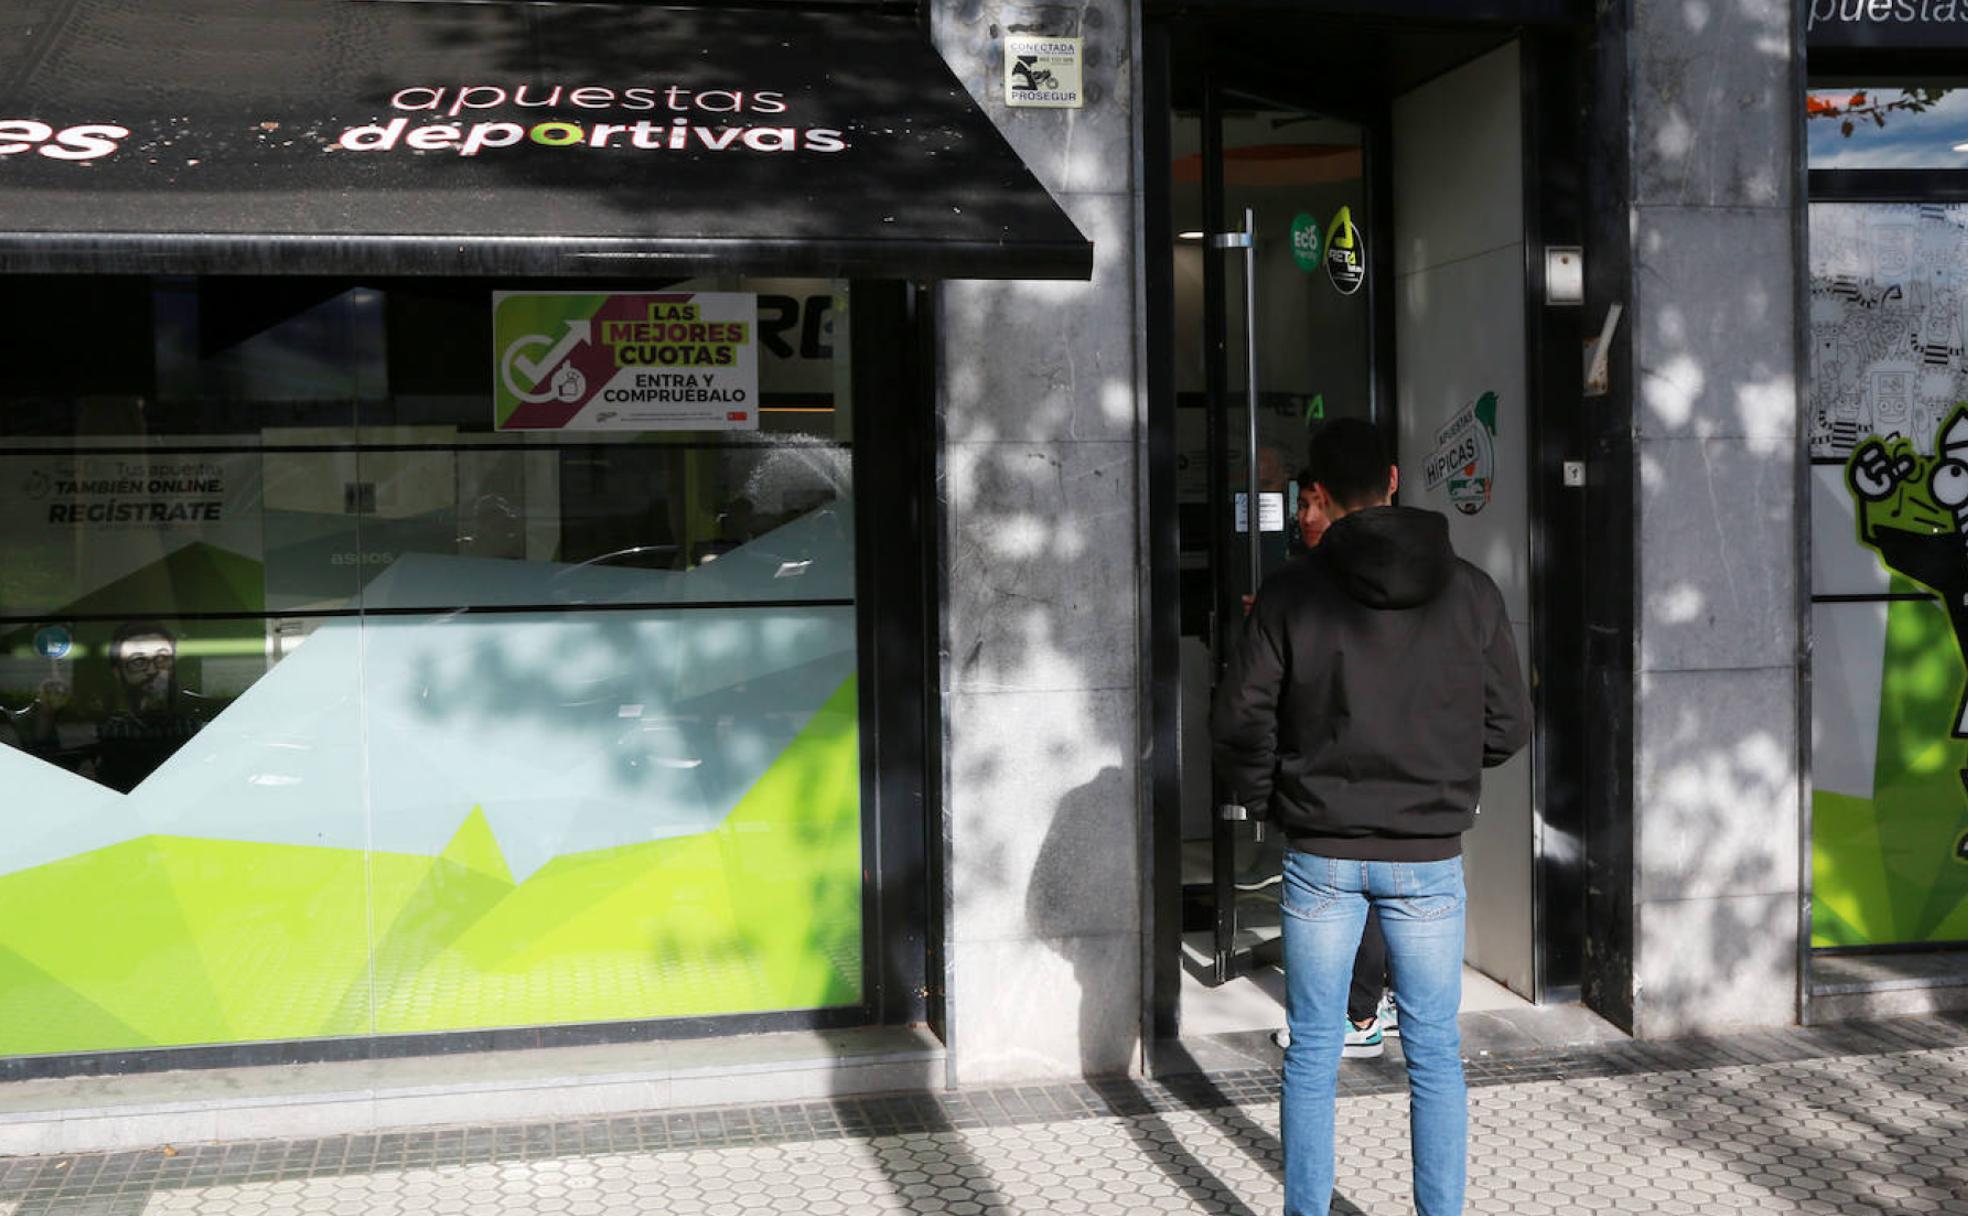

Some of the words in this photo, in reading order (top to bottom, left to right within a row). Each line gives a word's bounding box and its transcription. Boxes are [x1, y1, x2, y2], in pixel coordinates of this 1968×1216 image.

[392, 83, 787, 117] apuestas
[1011, 91, 1077, 101] PROSEGUR
[338, 117, 847, 156] deportivas
[653, 305, 695, 321] LAS
[609, 322, 744, 343] MEJORES
[619, 345, 733, 366] CUOTAS
[635, 373, 697, 388] ENTRA
[701, 373, 715, 388] Y
[603, 387, 746, 403] COMPRUÉBALO
[56, 478, 145, 495] TAMBIÉN
[49, 498, 223, 523] REGÍSTRATE
